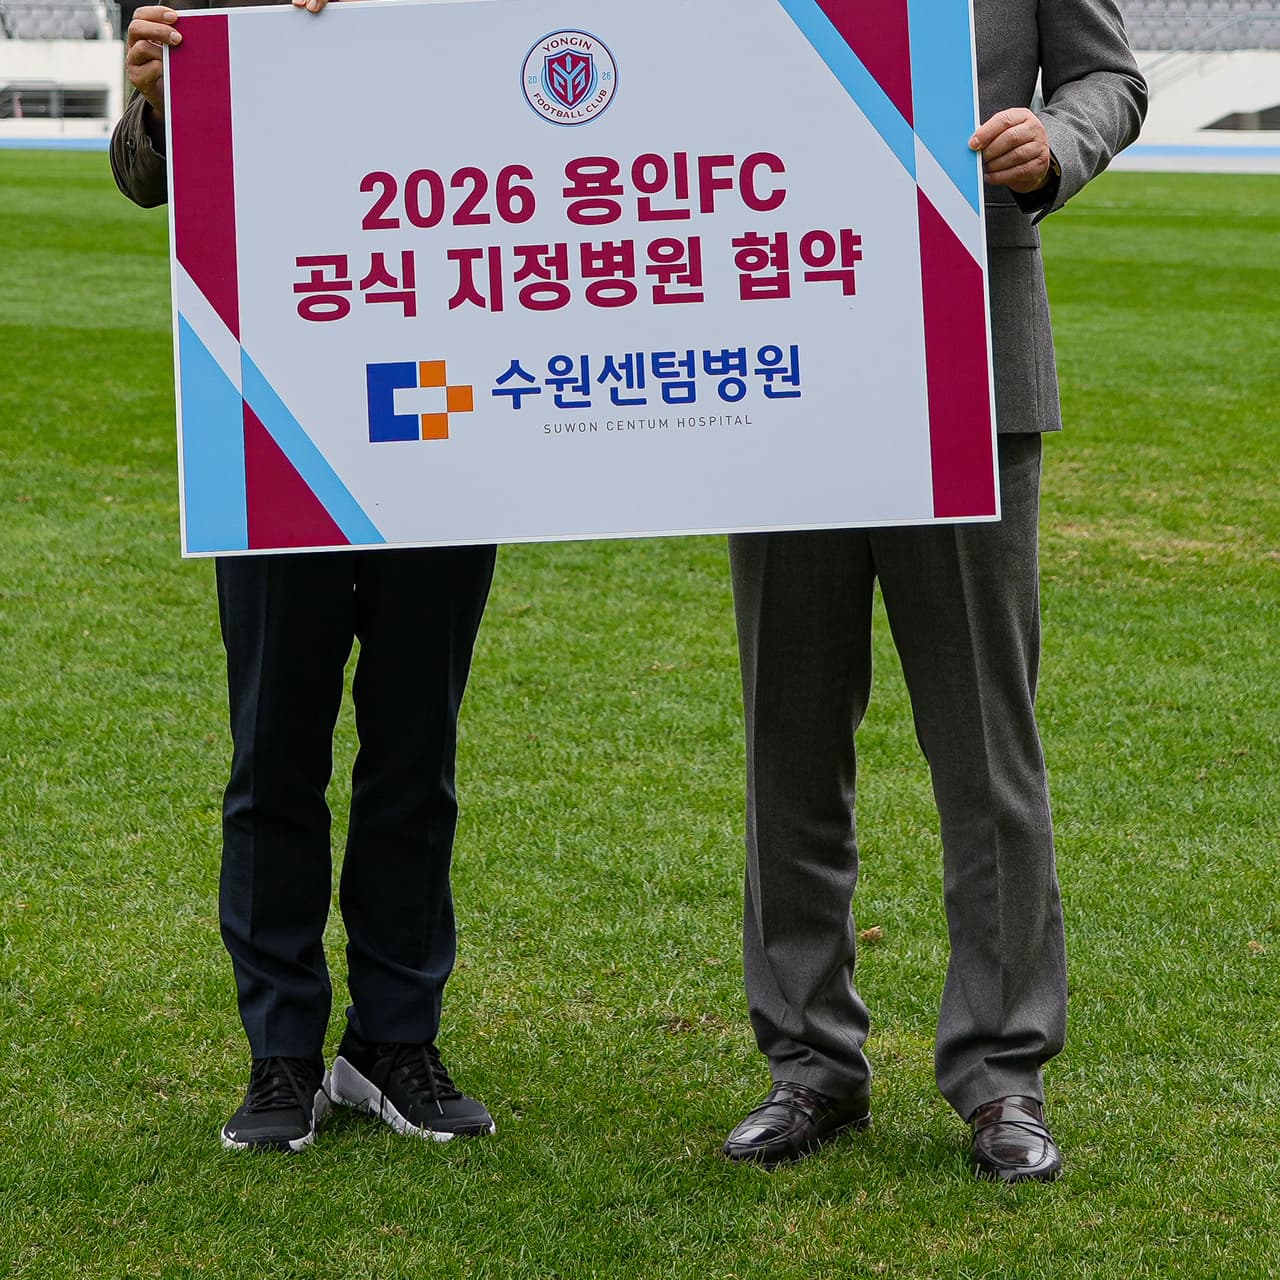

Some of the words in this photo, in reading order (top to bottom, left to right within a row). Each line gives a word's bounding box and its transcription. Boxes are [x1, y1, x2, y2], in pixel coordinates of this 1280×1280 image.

[543, 37, 592, 52] YONGIN
[528, 75, 538, 84] 20
[534, 92, 585, 118] FOOTBALL
[585, 89, 608, 113] CLUB
[360, 165, 535, 231] 2026
[563, 152, 786, 225] 용인FC
[293, 250, 417, 322] 공식
[447, 236, 705, 313] 지정병원
[732, 228, 863, 300] 협약
[491, 344, 802, 409] 수원센텀병원
[543, 422, 599, 434] SUWON
[606, 418, 669, 432] CENTUM
[677, 414, 753, 428] HOSPITAL
